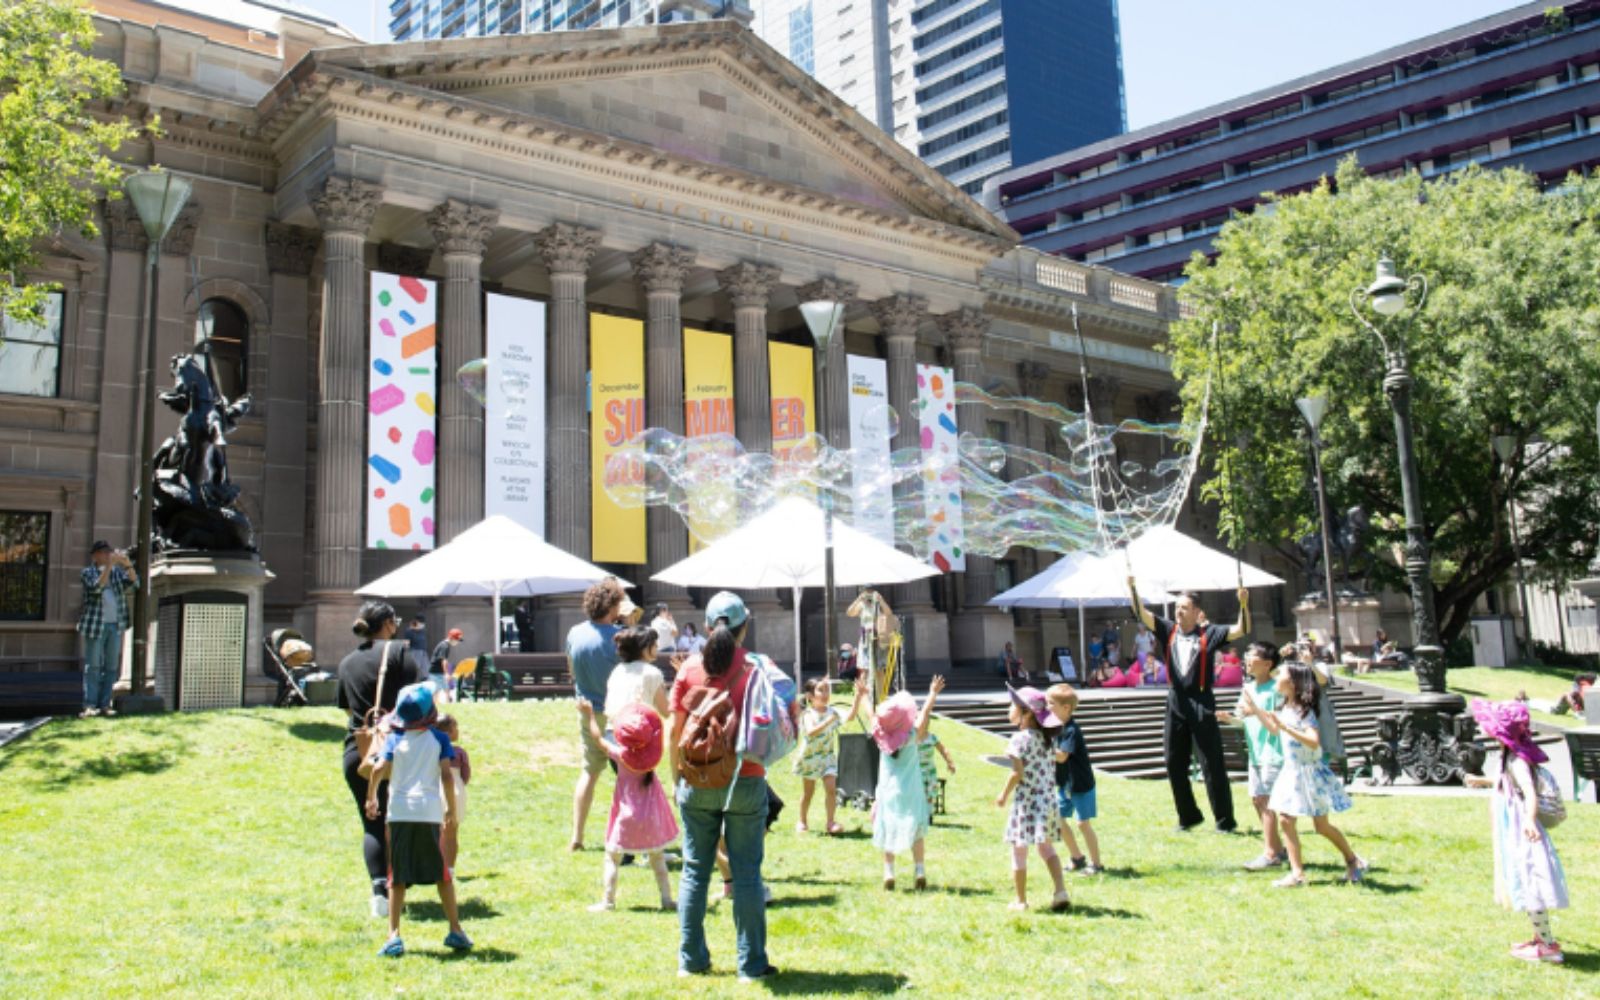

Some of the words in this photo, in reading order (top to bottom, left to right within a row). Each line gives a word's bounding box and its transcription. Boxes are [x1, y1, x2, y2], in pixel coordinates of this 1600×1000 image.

[630, 191, 791, 241] VICTORIA
[599, 384, 641, 393] December
[697, 384, 727, 393] February
[771, 397, 805, 442] ER
